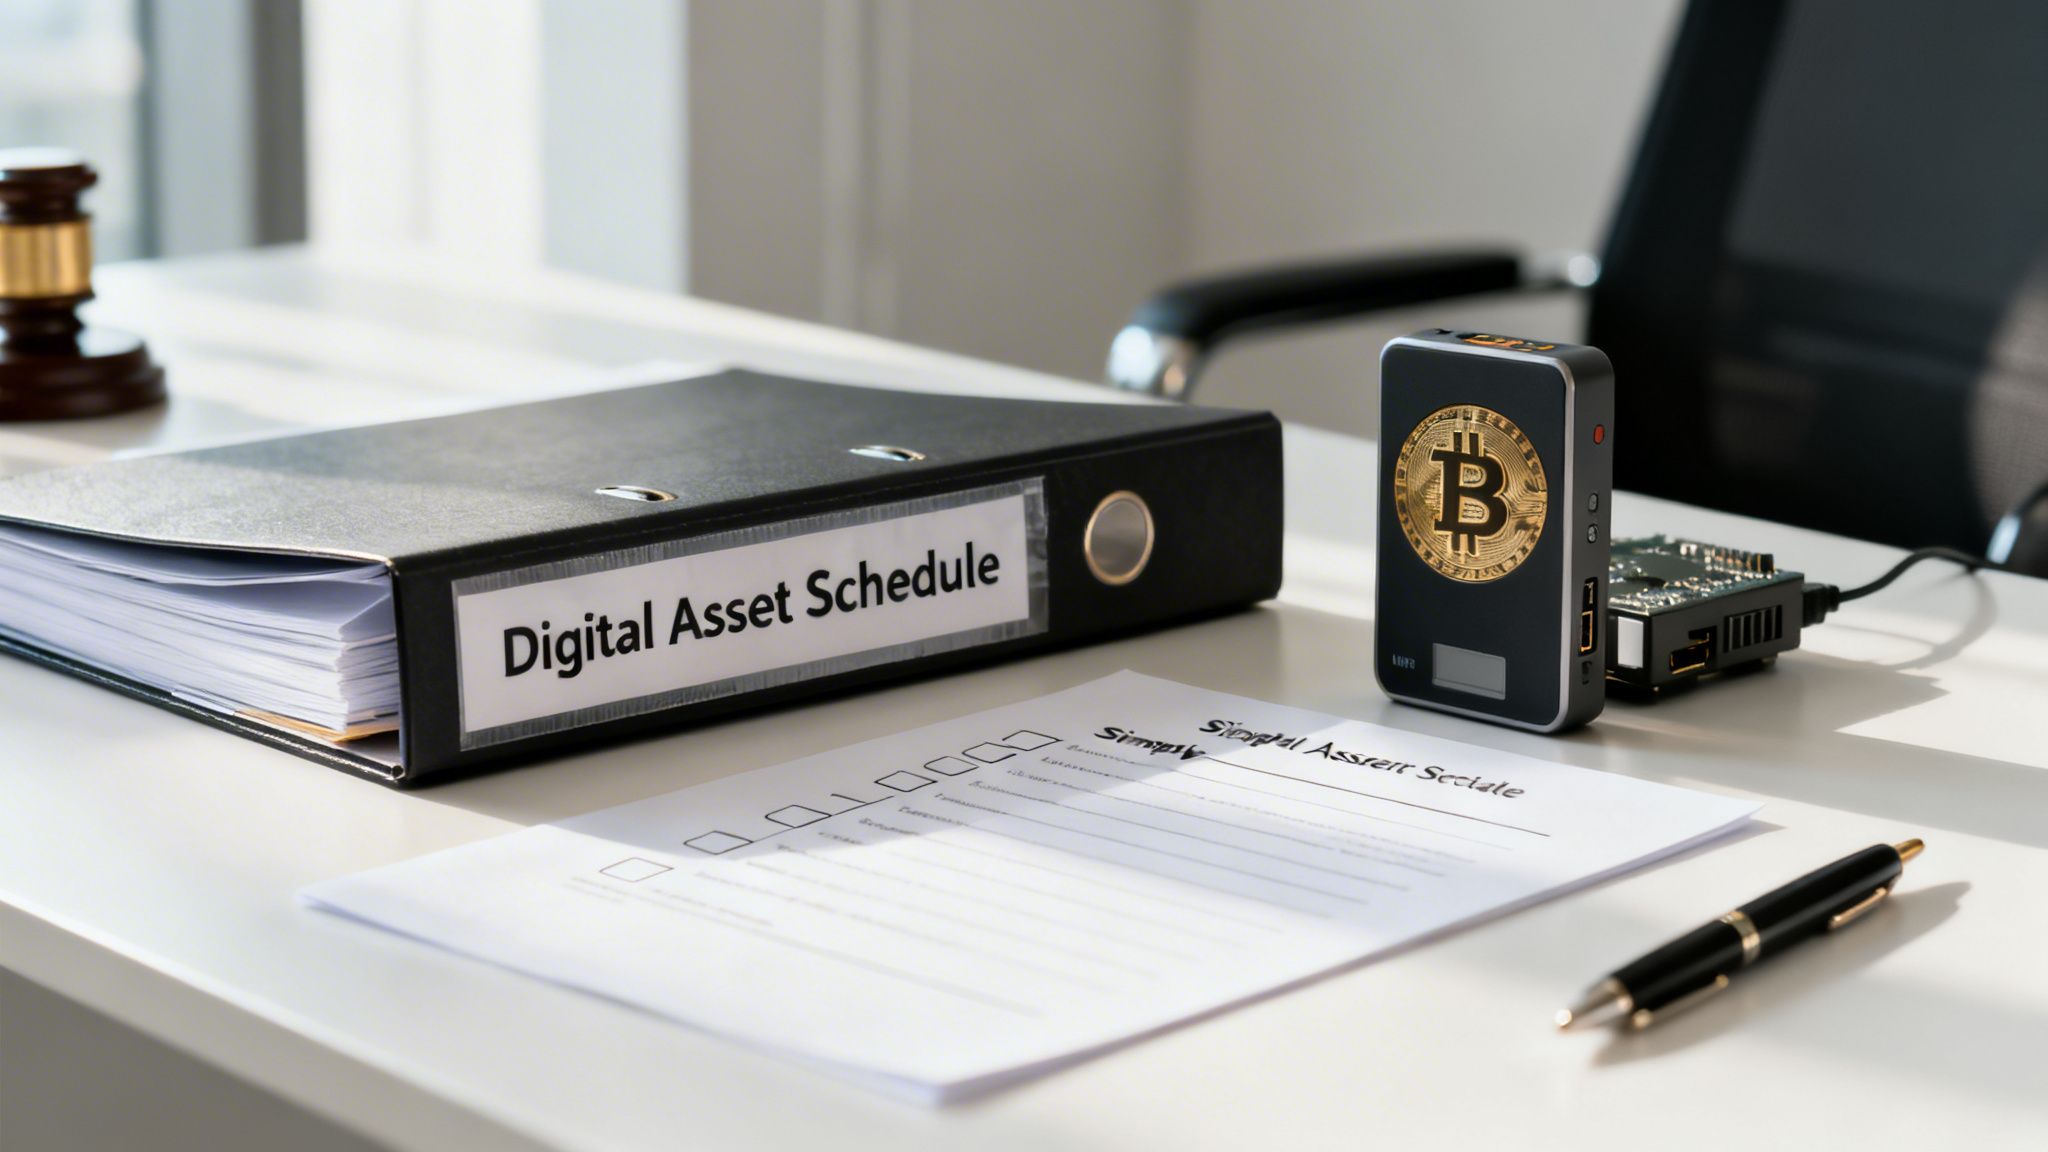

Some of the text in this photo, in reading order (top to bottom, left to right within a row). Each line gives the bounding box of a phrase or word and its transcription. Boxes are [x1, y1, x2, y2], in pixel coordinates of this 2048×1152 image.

[503, 541, 1001, 679] Digital Asset Schedule
